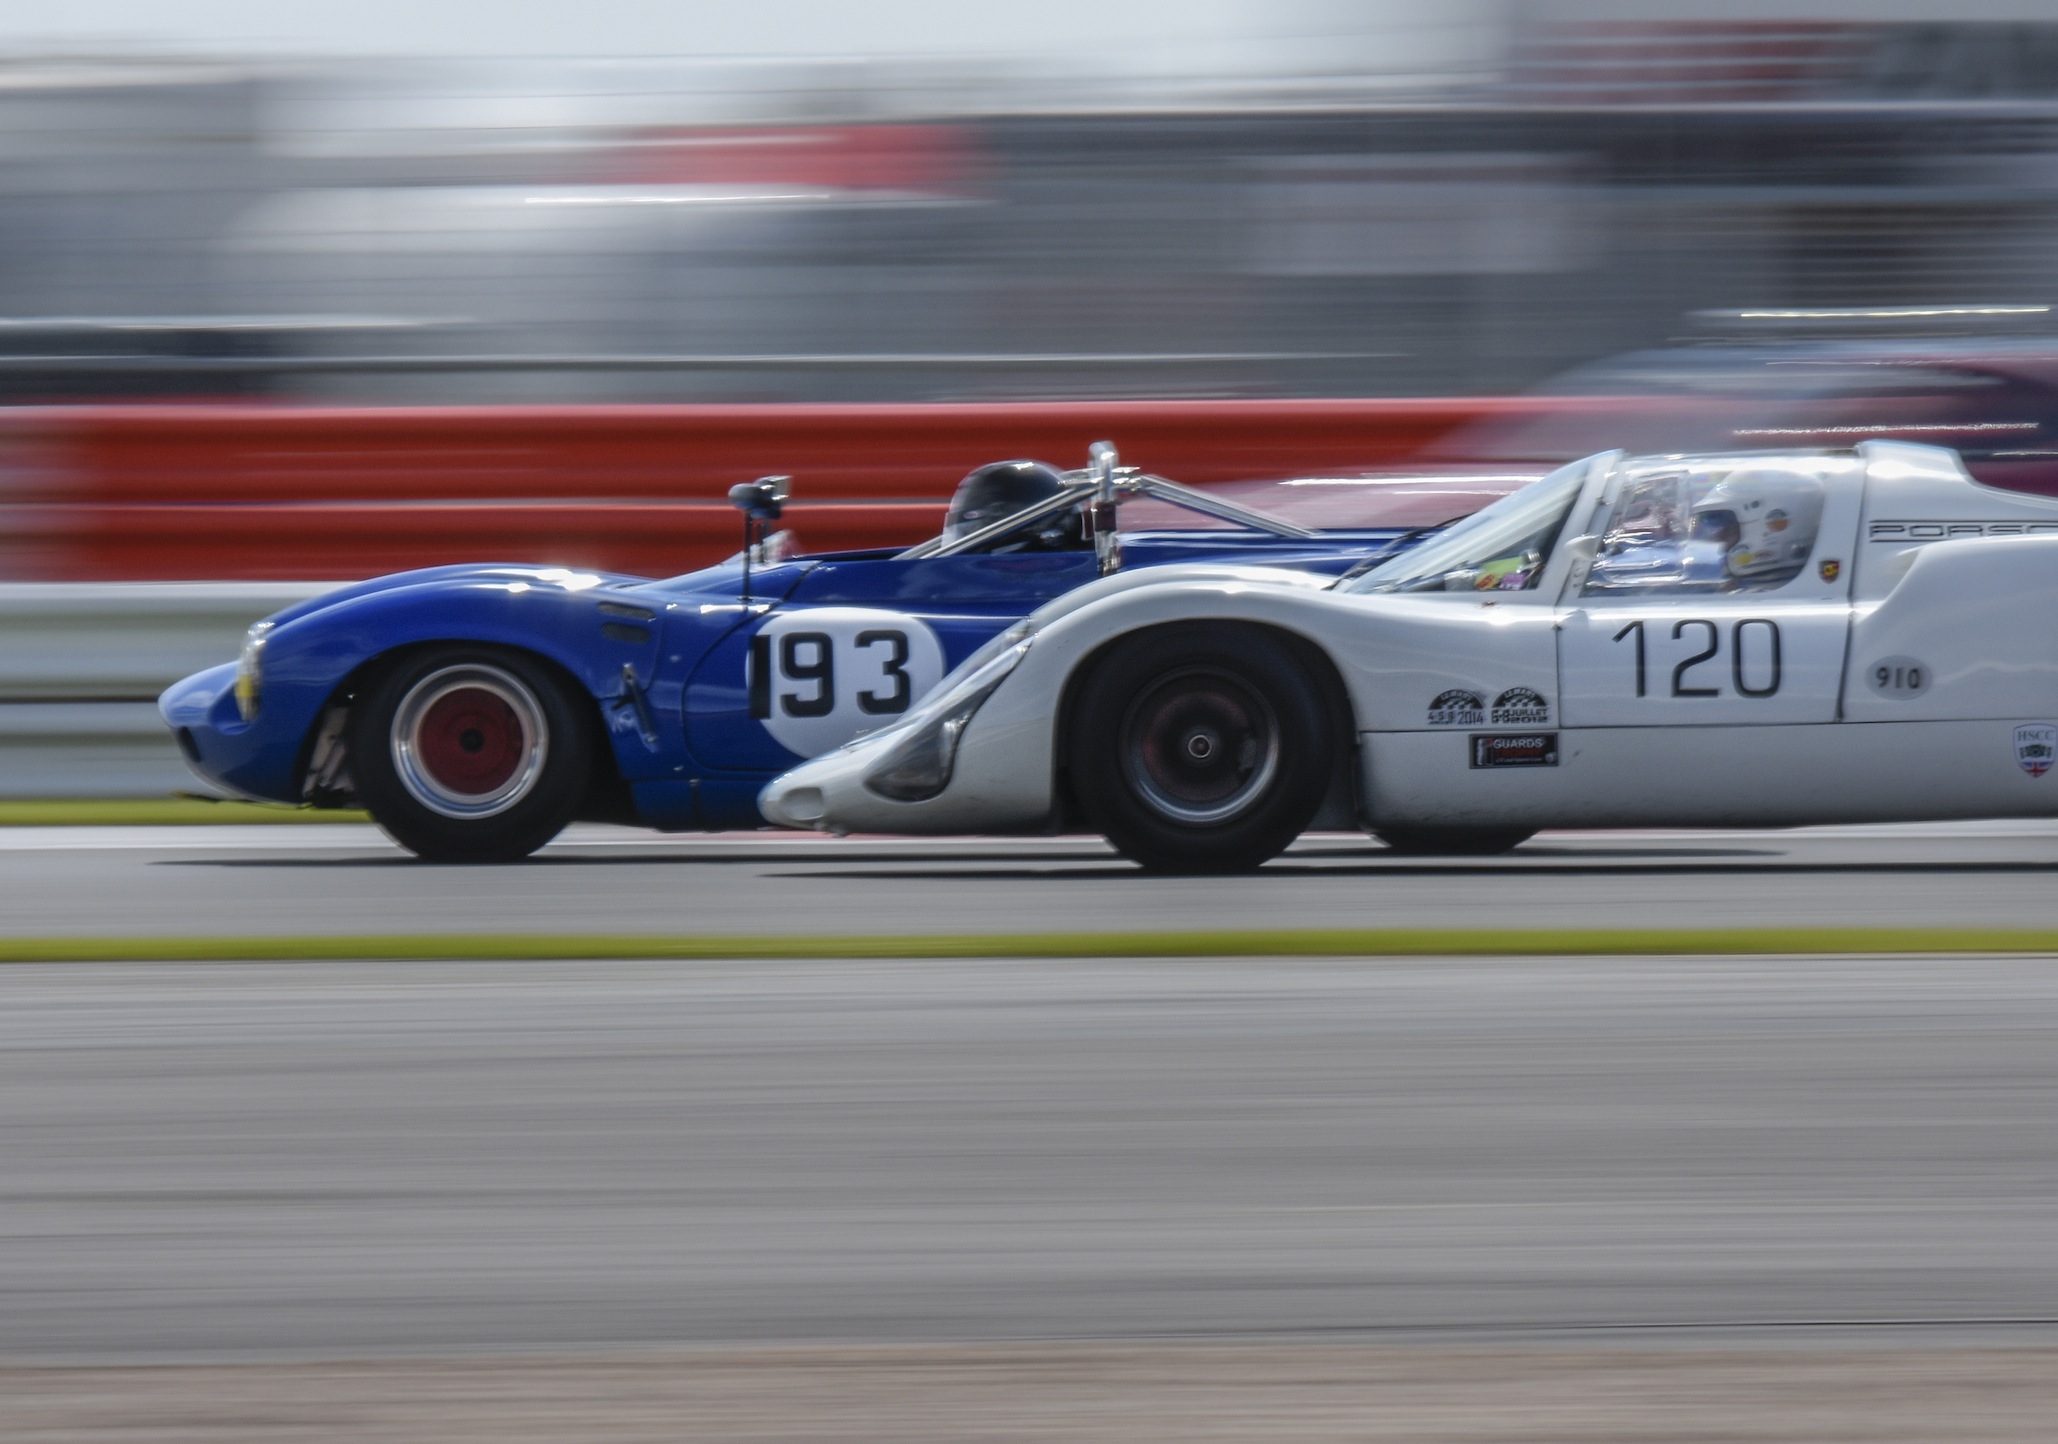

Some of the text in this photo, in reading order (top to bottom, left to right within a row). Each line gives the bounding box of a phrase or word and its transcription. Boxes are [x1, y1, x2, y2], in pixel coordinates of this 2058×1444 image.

[1611, 618, 1782, 699] 120
[749, 629, 911, 720] 193
[1875, 666, 1922, 690] 910
[1457, 711, 1484, 725] 2014
[1493, 738, 1543, 749] GUARDS
[2017, 730, 2055, 742] HSCC
